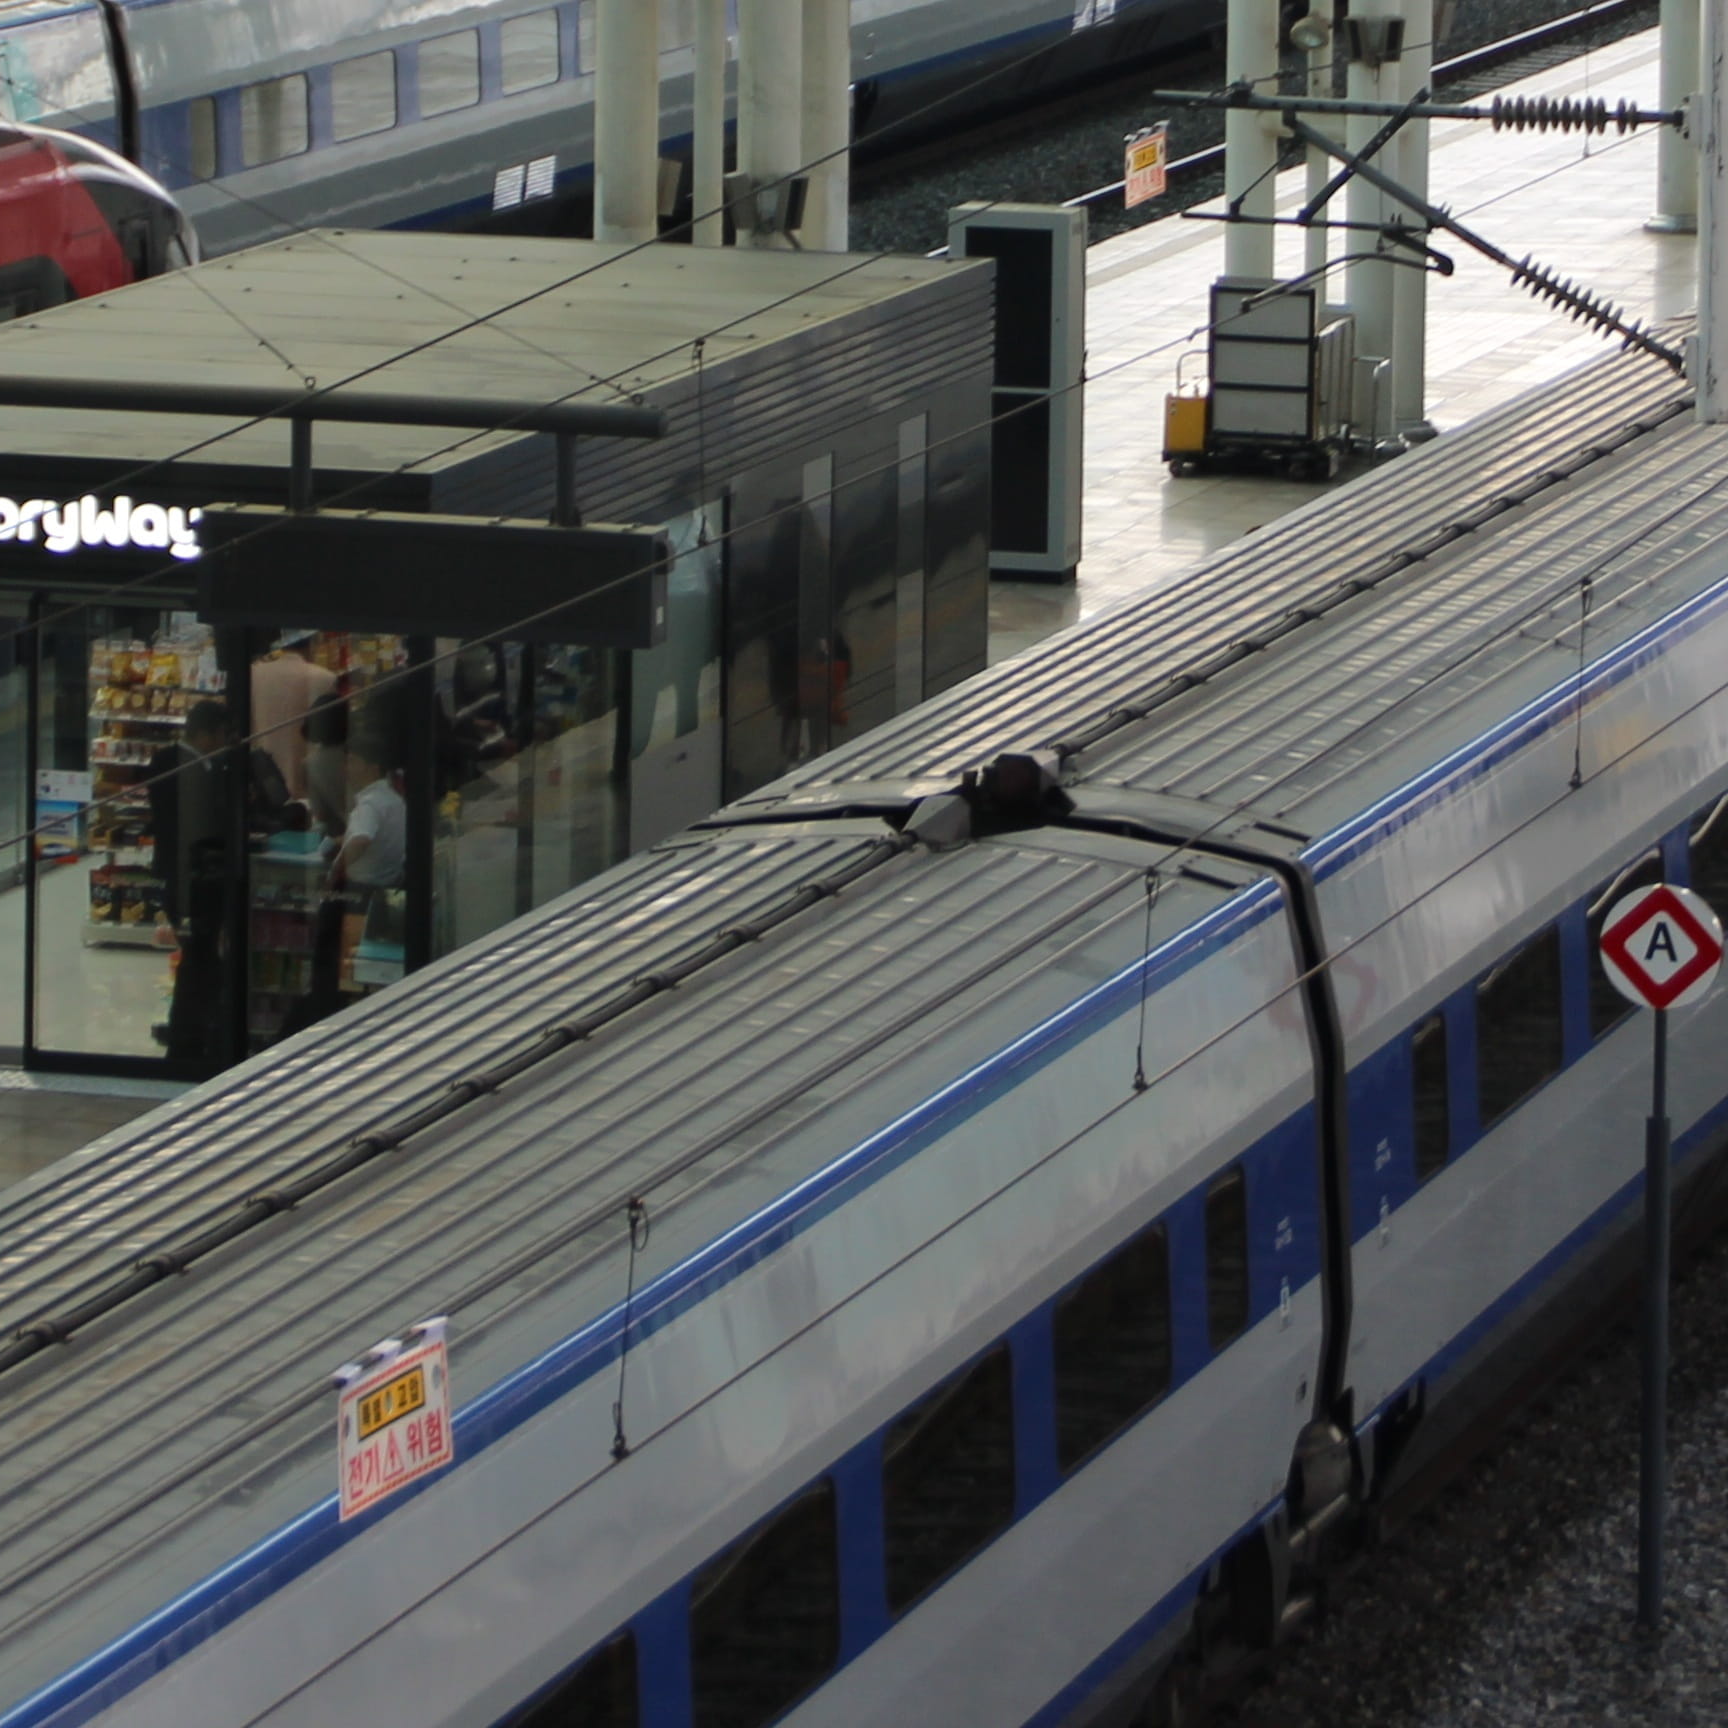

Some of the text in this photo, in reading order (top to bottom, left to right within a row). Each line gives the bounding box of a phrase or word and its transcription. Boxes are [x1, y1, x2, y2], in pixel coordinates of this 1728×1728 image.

[1644, 922, 1677, 962] A
[349, 1407, 443, 1502] 전기 위험
